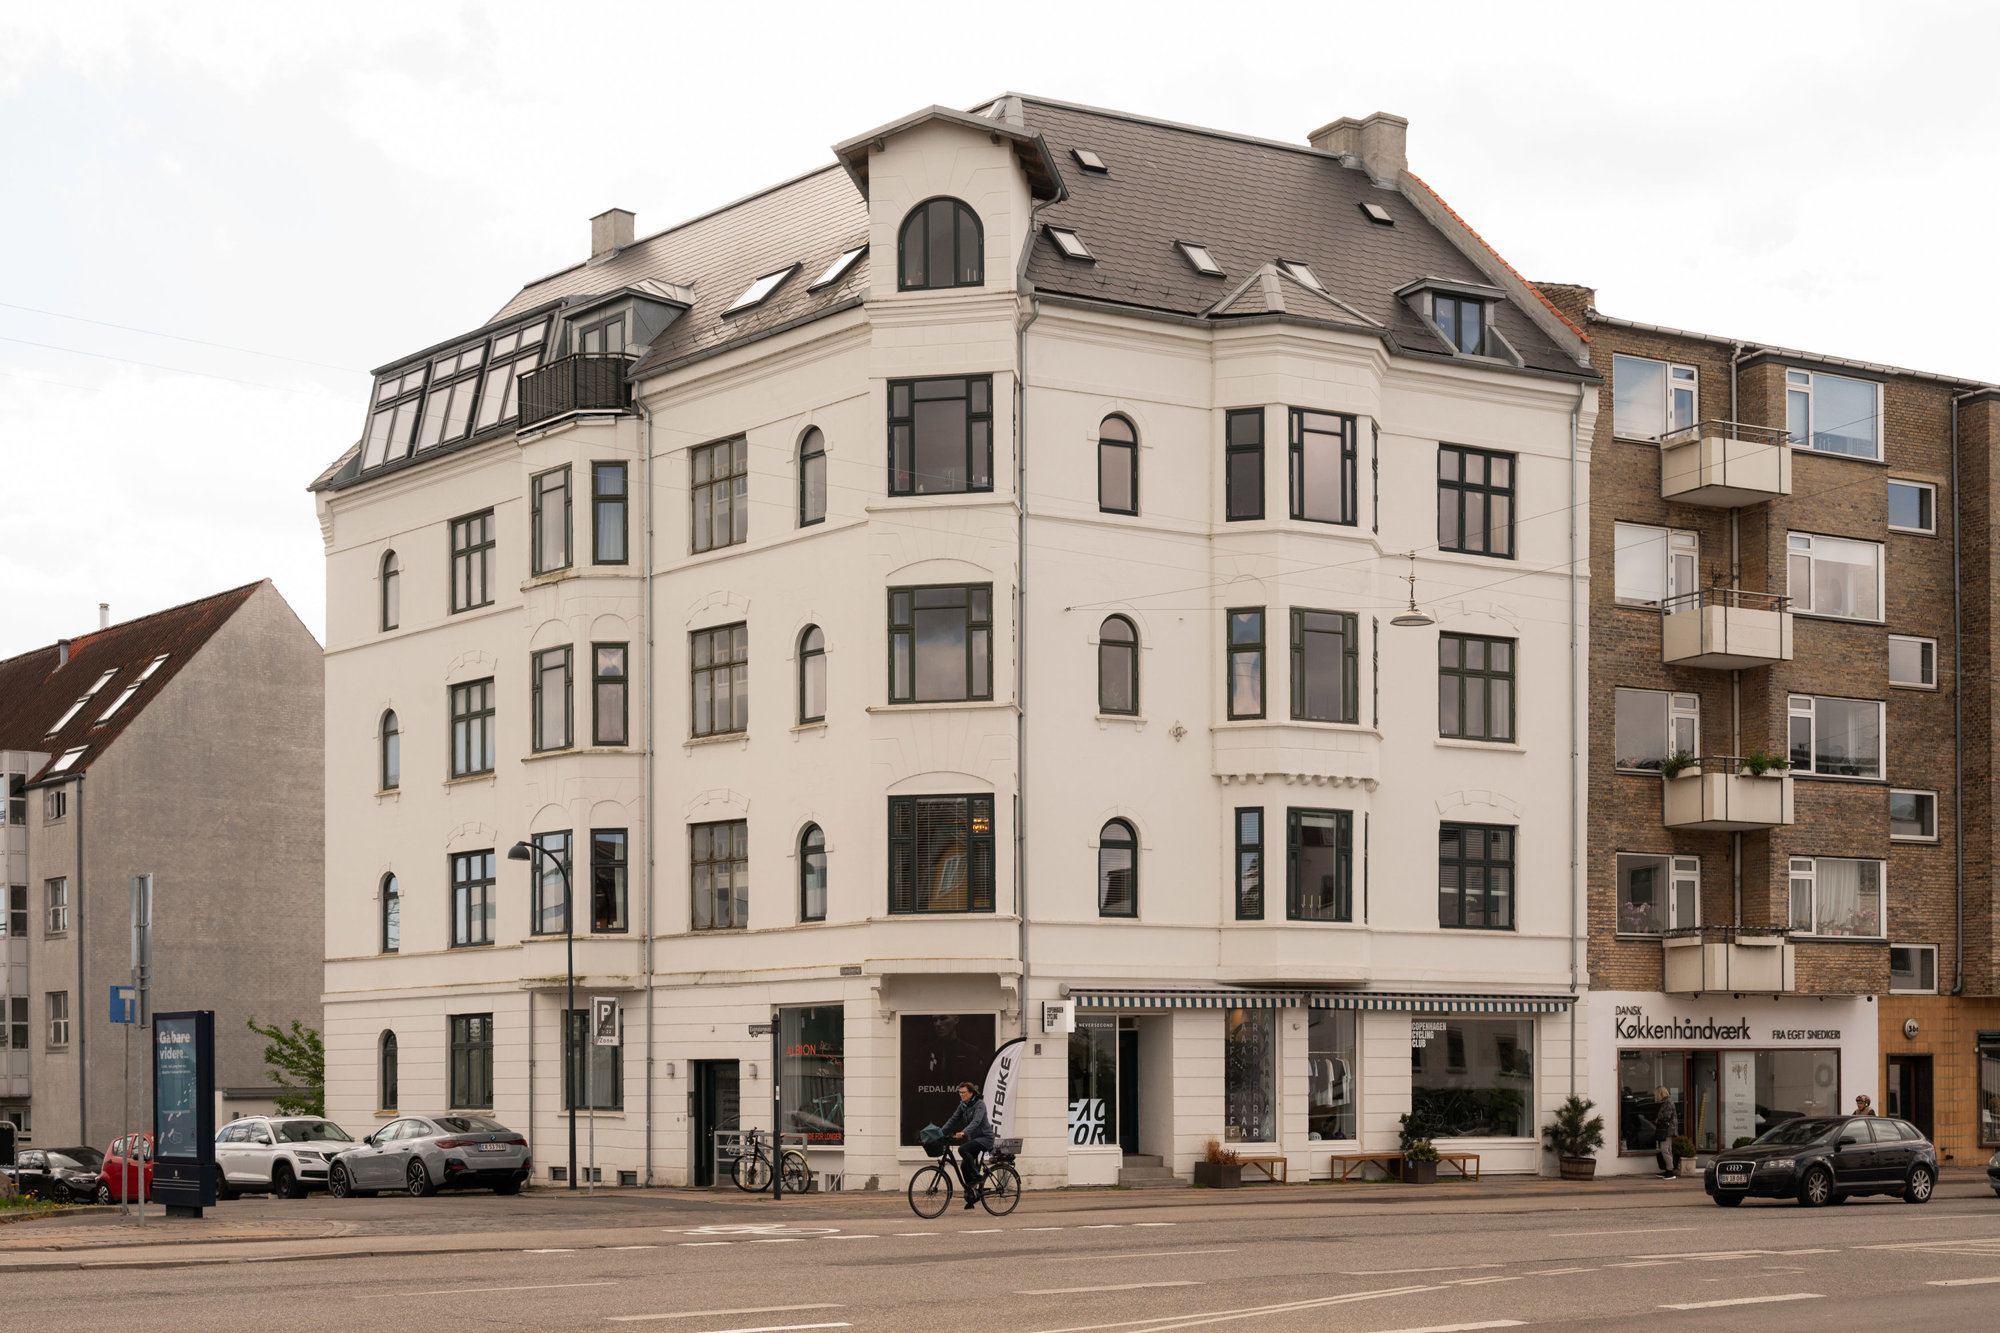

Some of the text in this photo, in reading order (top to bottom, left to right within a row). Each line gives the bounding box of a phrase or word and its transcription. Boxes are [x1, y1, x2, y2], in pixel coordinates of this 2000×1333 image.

[601, 1004, 611, 1021] P
[1615, 1005, 1642, 1016] DANSK
[1412, 1022, 1447, 1031] COPENHAGEN
[1616, 1016, 1751, 1040] Køkkenhåndværk
[171, 1031, 190, 1043] bare
[1412, 1031, 1434, 1039] CYCLING
[1772, 1030, 1786, 1040] FRA
[1787, 1030, 1806, 1040] EGET
[1412, 1039, 1426, 1048] CLUB
[786, 1044, 816, 1056] ALBION
[918, 1085, 945, 1093] PEDAL
[991, 1056, 1012, 1139] FITBIKE
[1230, 1104, 1270, 1114] FARA
[1230, 1116, 1270, 1126] FARA
[815, 1132, 823, 1140] FOR
[824, 1132, 842, 1141] LONGER
[1230, 1128, 1271, 1137] FARA
